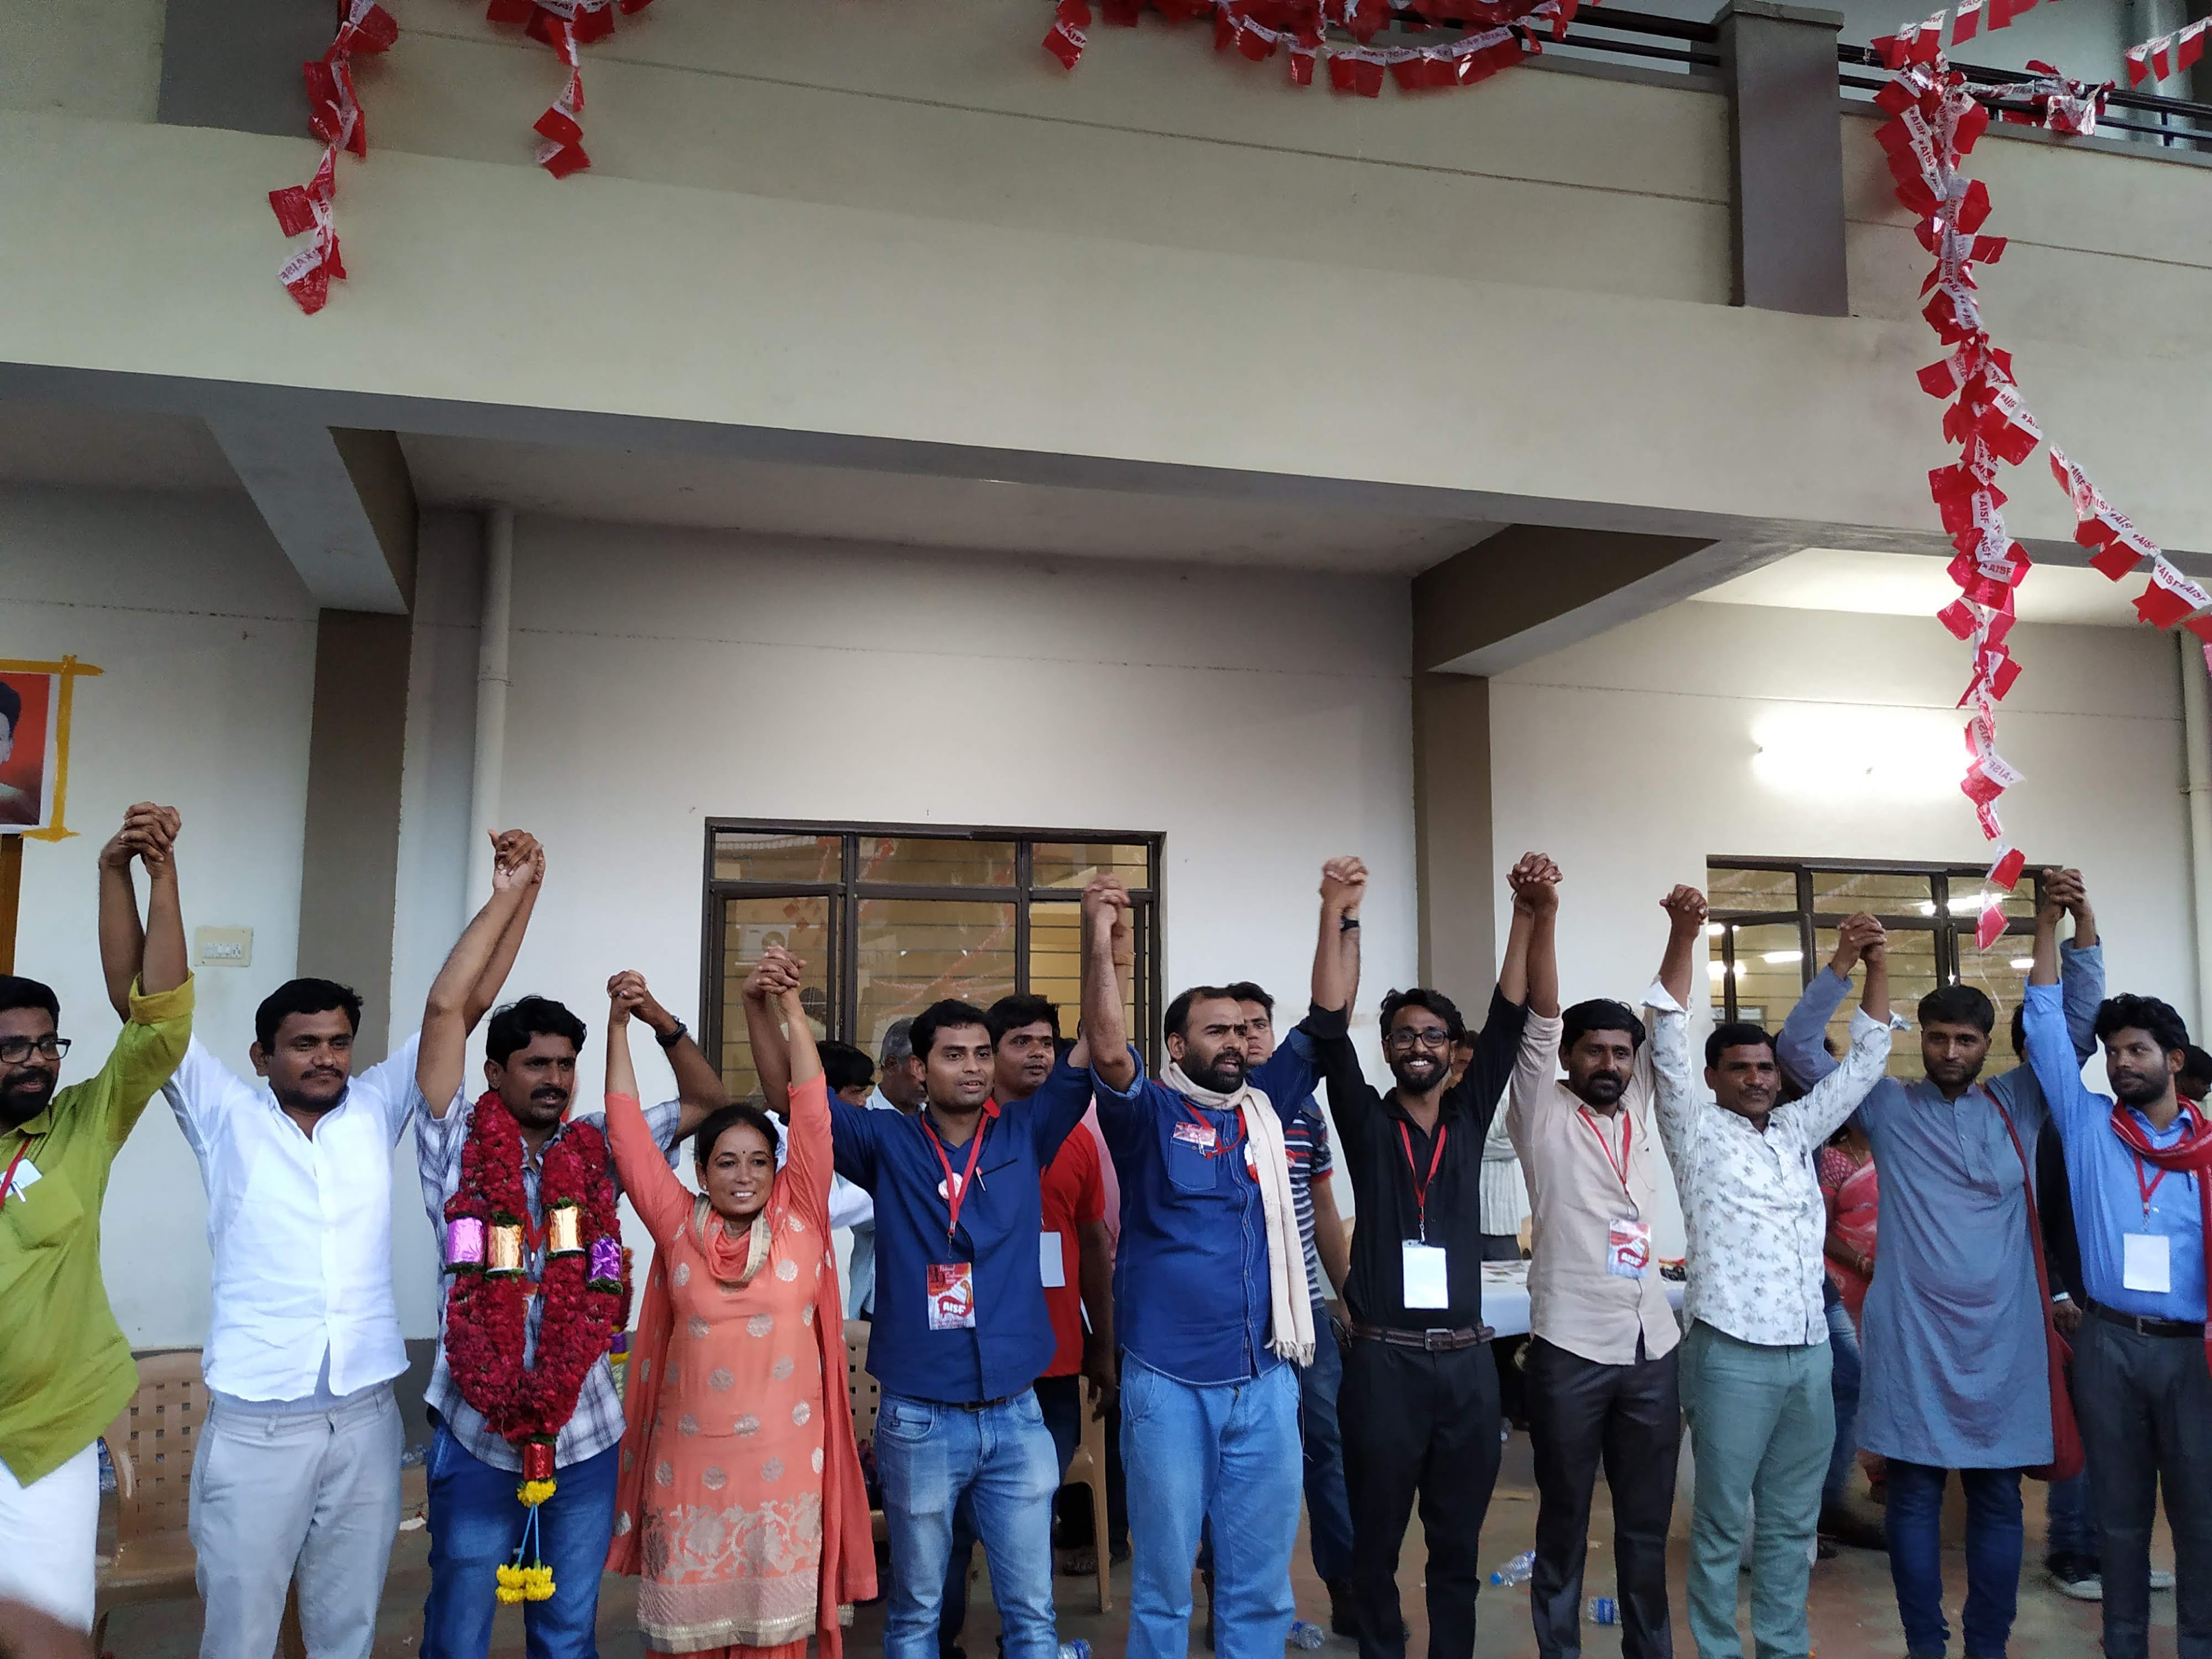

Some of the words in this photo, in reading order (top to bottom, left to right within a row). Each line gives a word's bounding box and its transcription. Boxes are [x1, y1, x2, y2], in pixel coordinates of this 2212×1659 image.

[1979, 501, 1989, 524] AISF
[1988, 564, 2012, 576] AISF
[2159, 567, 2180, 587] AISF
[943, 1301, 967, 1315] AISF
